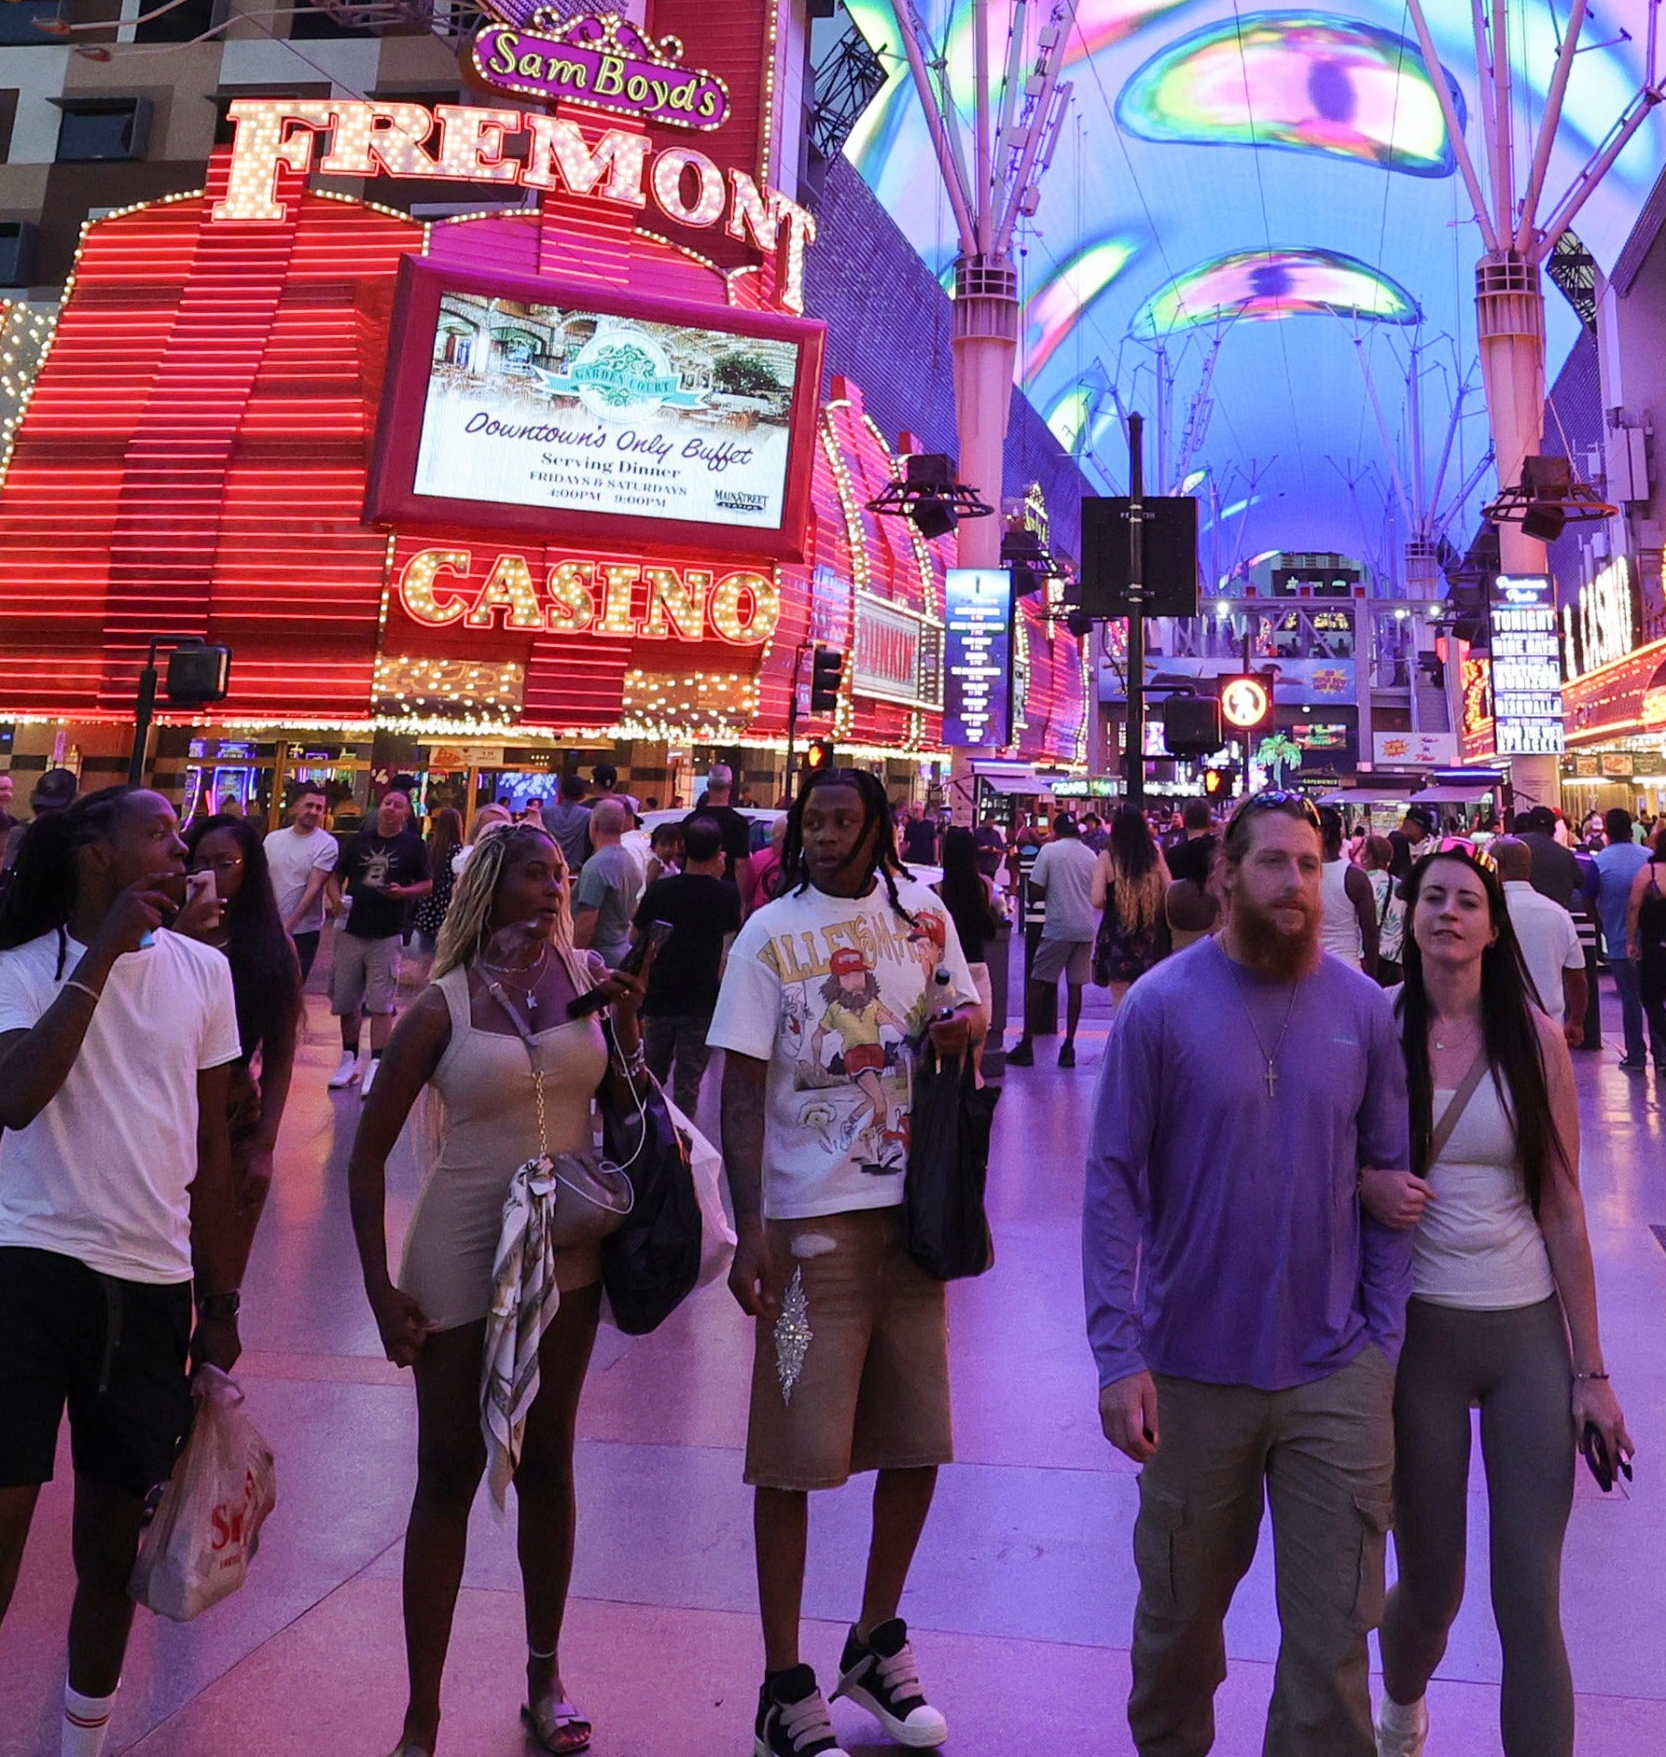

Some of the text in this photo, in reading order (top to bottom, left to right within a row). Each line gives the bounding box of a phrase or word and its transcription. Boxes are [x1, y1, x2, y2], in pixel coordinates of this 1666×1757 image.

[487, 30, 718, 119] Sam Boyd's
[211, 99, 817, 316] FREMONT
[574, 368, 672, 394] GARDEN COURT
[464, 412, 754, 473] Downtown's Only Buffet
[541, 450, 682, 479] Serving Dinner
[529, 470, 591, 488] FRIDAYS
[606, 479, 688, 497] SATURDAYS
[548, 488, 667, 509] 4:00PM 9:00PM
[398, 546, 783, 648] CASINO
[1492, 610, 1555, 631] TONIGHT
